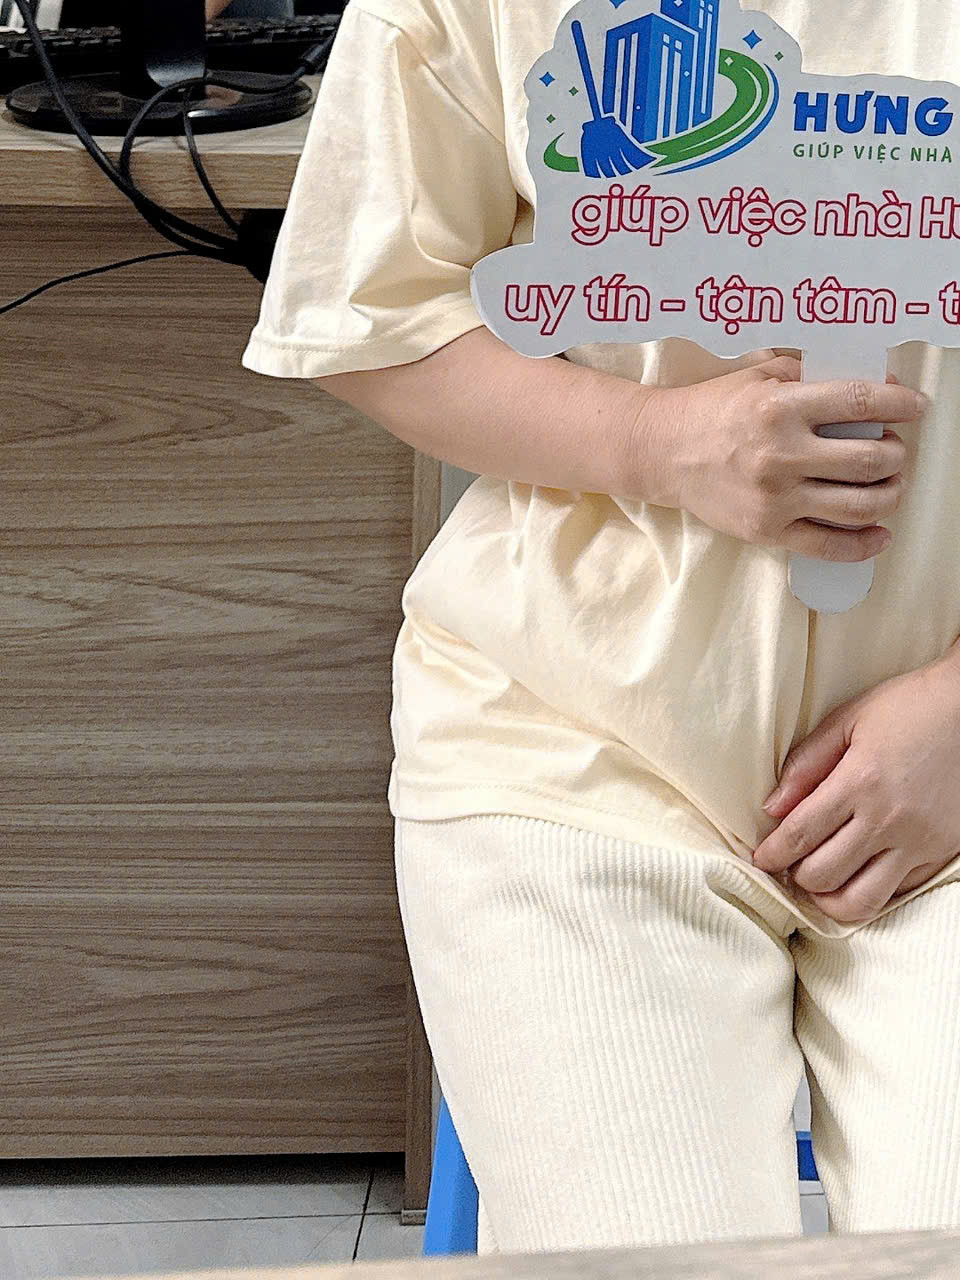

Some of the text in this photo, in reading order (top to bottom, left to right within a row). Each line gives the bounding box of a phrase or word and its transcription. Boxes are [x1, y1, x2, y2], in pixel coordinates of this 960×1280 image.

[793, 90, 954, 137] HƯNG
[793, 142, 844, 160] GIÚP
[853, 144, 901, 163] VIỆC
[910, 146, 952, 163] NHÀ
[571, 184, 690, 247] giúp
[698, 186, 807, 248] việc
[814, 190, 912, 237] nhà
[504, 284, 576, 336] uy
[583, 273, 651, 322] tín
[660, 299, 686, 312] -
[695, 274, 784, 335] tận
[792, 274, 897, 324] tâm
[905, 302, 930, 315] -
